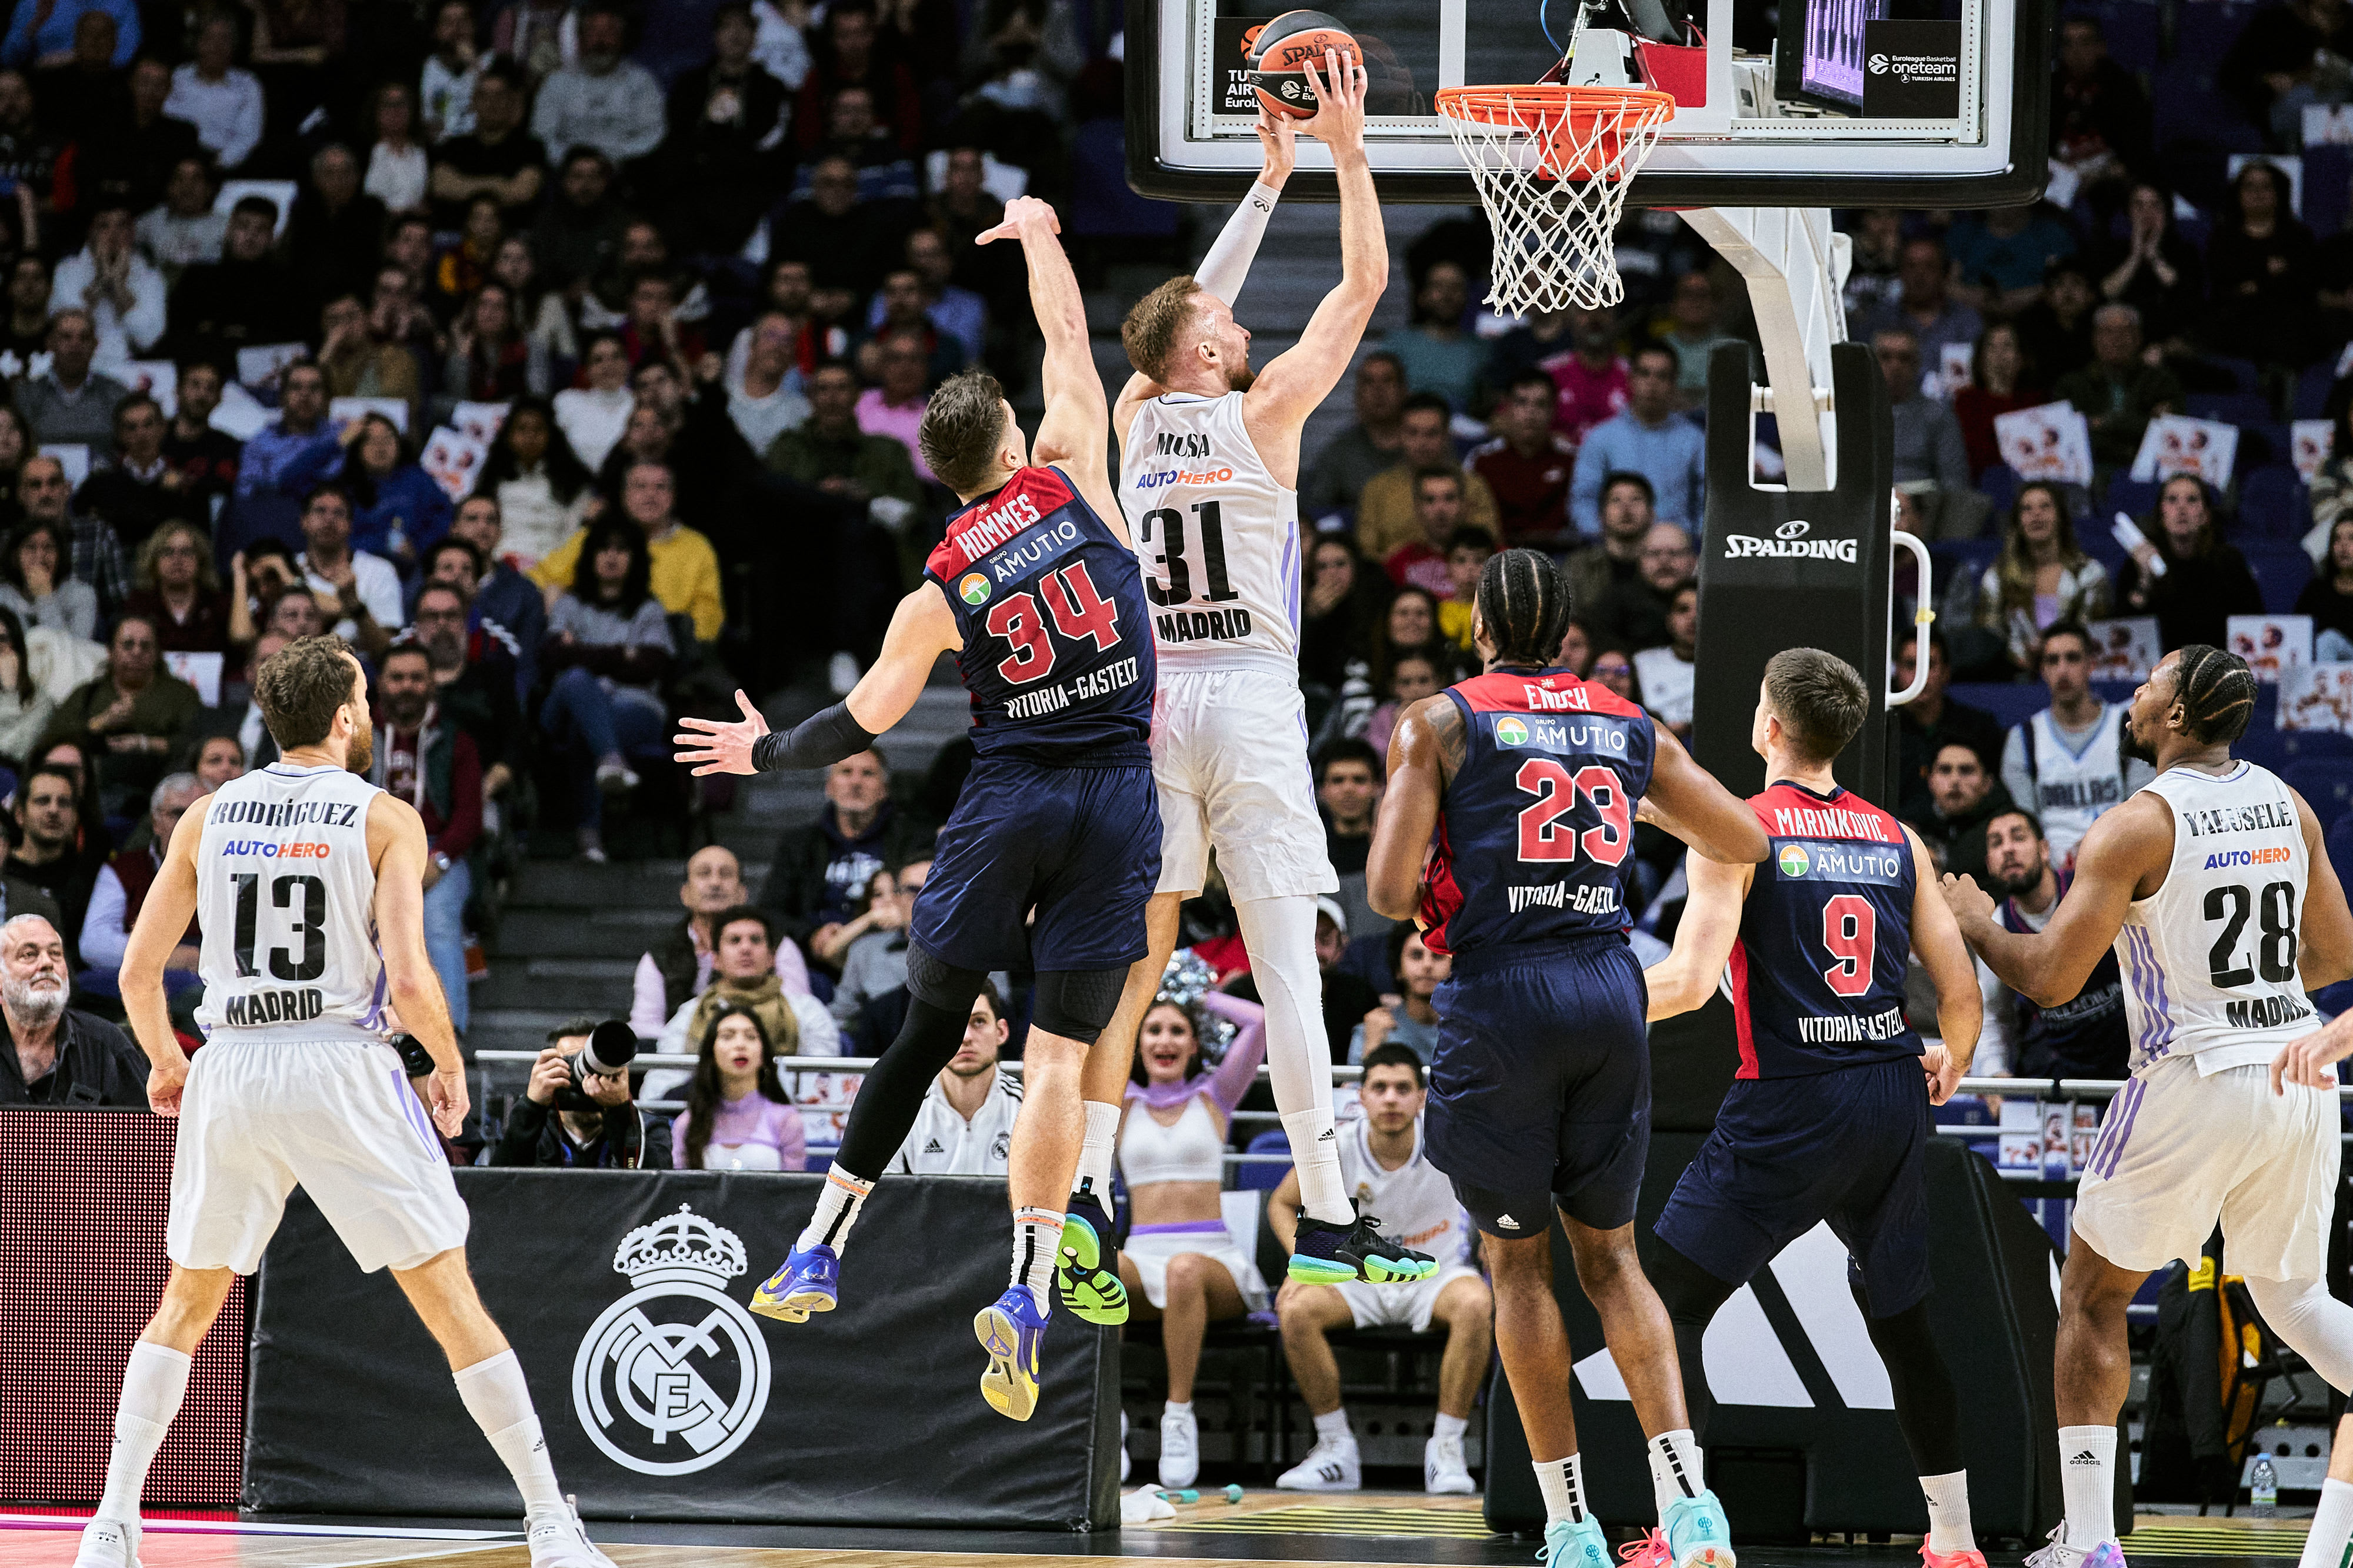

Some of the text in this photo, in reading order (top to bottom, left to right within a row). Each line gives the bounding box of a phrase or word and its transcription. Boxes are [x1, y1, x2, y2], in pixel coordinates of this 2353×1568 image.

[1891, 62, 1957, 75] oneteam
[1155, 432, 1211, 459] MUSA
[1136, 468, 1233, 489] AUTOHERO
[954, 493, 1042, 563] HOMMES
[989, 550, 1007, 565] GRUPO
[993, 521, 1077, 583] AMUTIO
[1141, 500, 1239, 607] 31
[1724, 534, 1858, 563] SPALDING
[985, 559, 1122, 685] 34
[1156, 608, 1252, 643] MADRID
[1003, 656, 1139, 719] VITORIA-GASTEIZ
[1523, 684, 1591, 710] ENOCH
[1535, 726, 1626, 752] AMUTIO
[211, 798, 359, 828] RODRÍGUEZ
[1774, 808, 1888, 843] MARINKOVIC
[2182, 800, 2292, 837] YABUSELE
[222, 840, 330, 859] AUTOHERO
[1817, 853, 1899, 878] AMUTIO
[2204, 847, 2291, 870] AUTOHERO
[230, 872, 326, 981] 13
[2203, 880, 2297, 989] 28
[1823, 894, 1876, 997] 9
[225, 987, 324, 1026] MADRID
